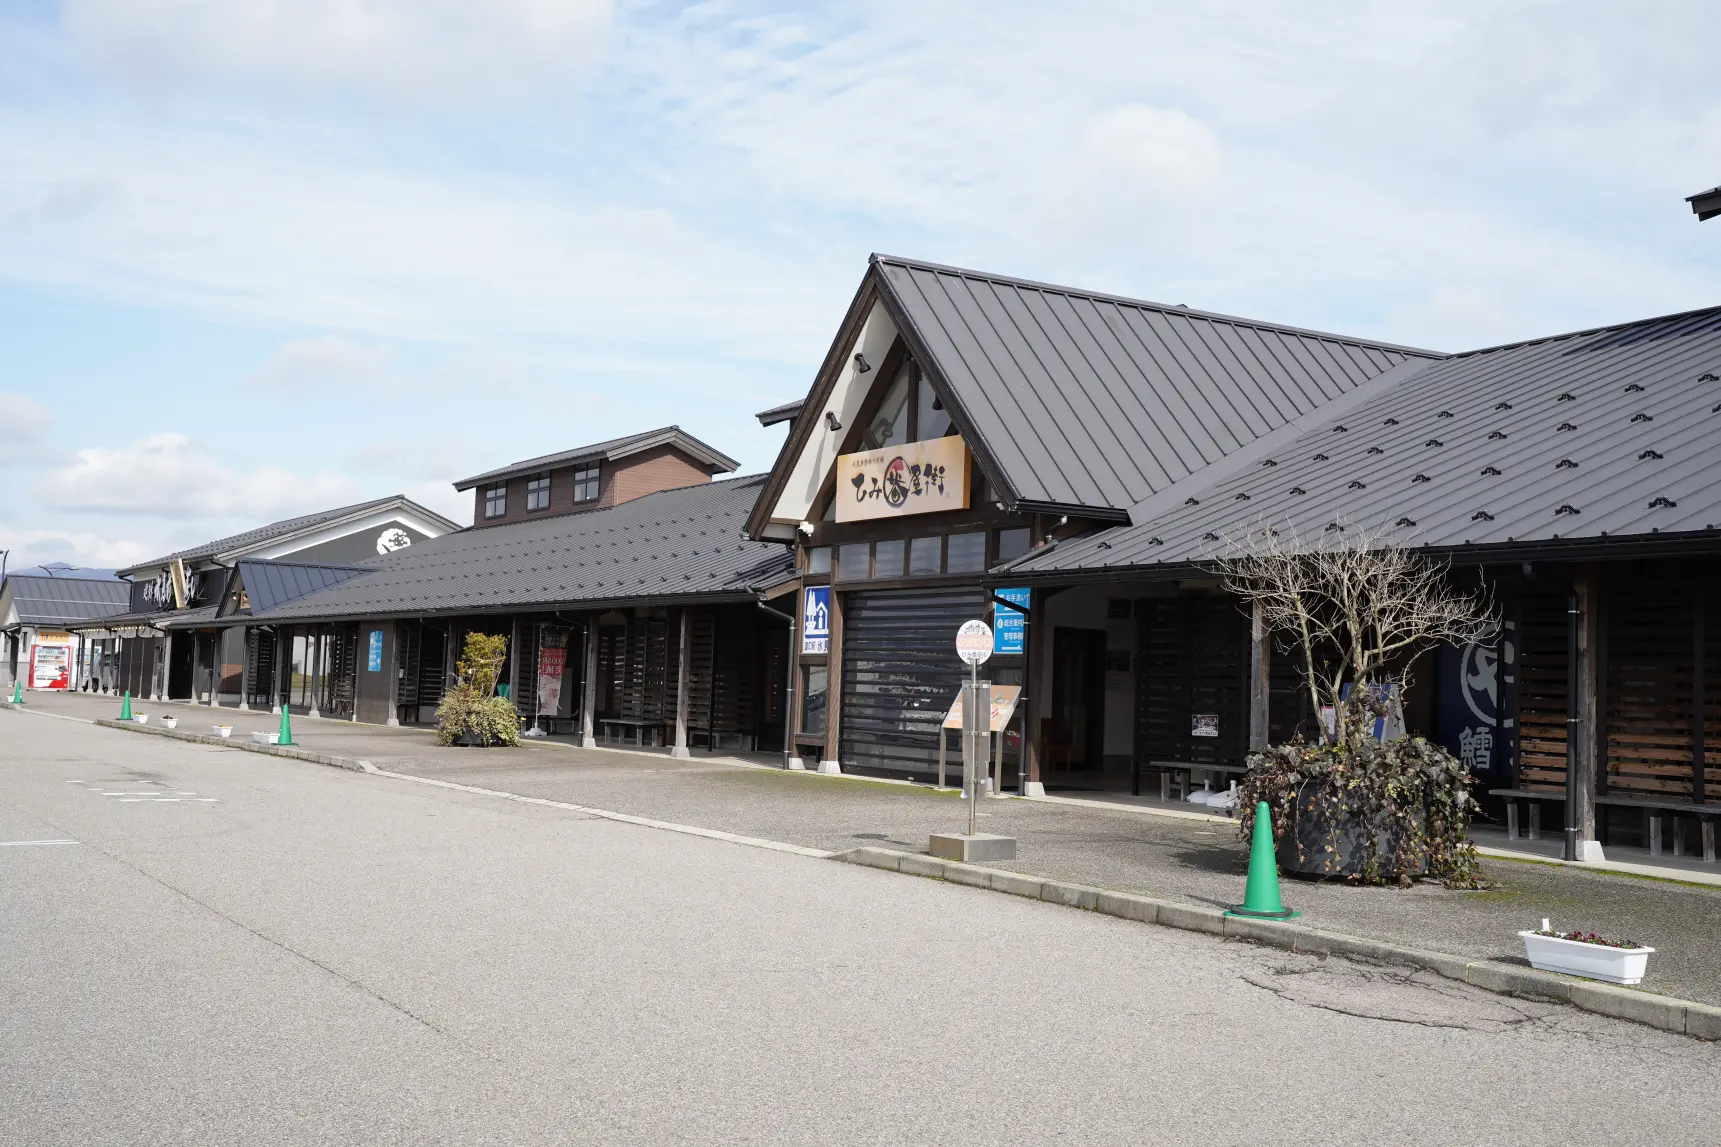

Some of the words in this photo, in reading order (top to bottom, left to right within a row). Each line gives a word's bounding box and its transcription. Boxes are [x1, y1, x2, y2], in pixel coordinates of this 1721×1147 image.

[850, 460, 946, 507] ひみ番屋街
